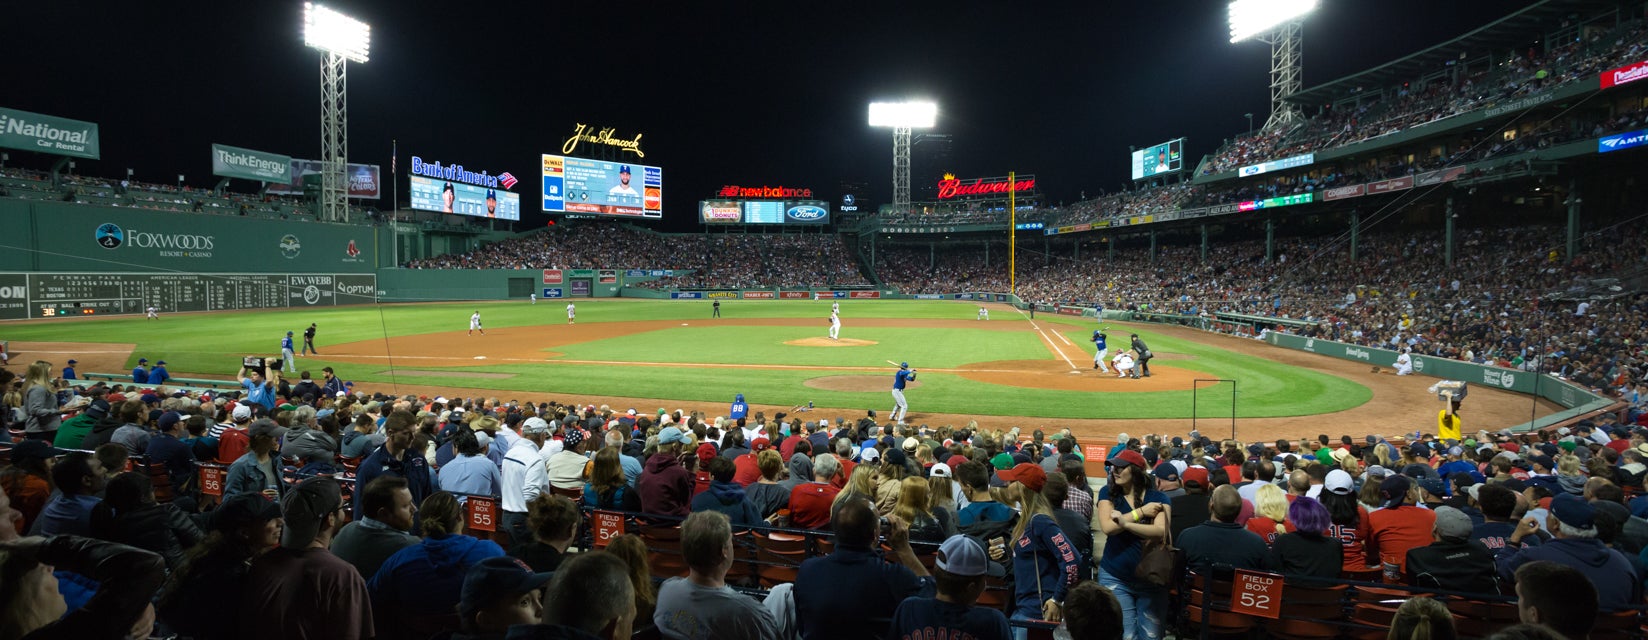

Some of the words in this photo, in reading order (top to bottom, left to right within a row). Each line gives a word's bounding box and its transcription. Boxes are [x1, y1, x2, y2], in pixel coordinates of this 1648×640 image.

[7, 118, 88, 144] National
[37, 139, 53, 148] Car
[56, 142, 84, 152] Rental
[598, 128, 645, 158] Hancock
[218, 150, 285, 174] ThinkEnergy
[411, 156, 444, 178] Bank
[444, 164, 456, 180] of
[457, 165, 498, 188] America
[937, 178, 1036, 199] Budweiser
[794, 205, 819, 217] Ford
[127, 229, 214, 250] FOXWOODS
[308, 276, 331, 286] WEBB
[346, 285, 374, 294] OPTUM
[1484, 375, 1500, 385] Nine
[206, 480, 219, 490] 56
[473, 513, 491, 526] 55
[599, 514, 620, 522] FIELD
[602, 520, 617, 528] BOX
[1329, 525, 1355, 546] 15
[1242, 574, 1274, 585] FIELD
[1245, 582, 1268, 592] BOX
[1240, 592, 1270, 609] 52
